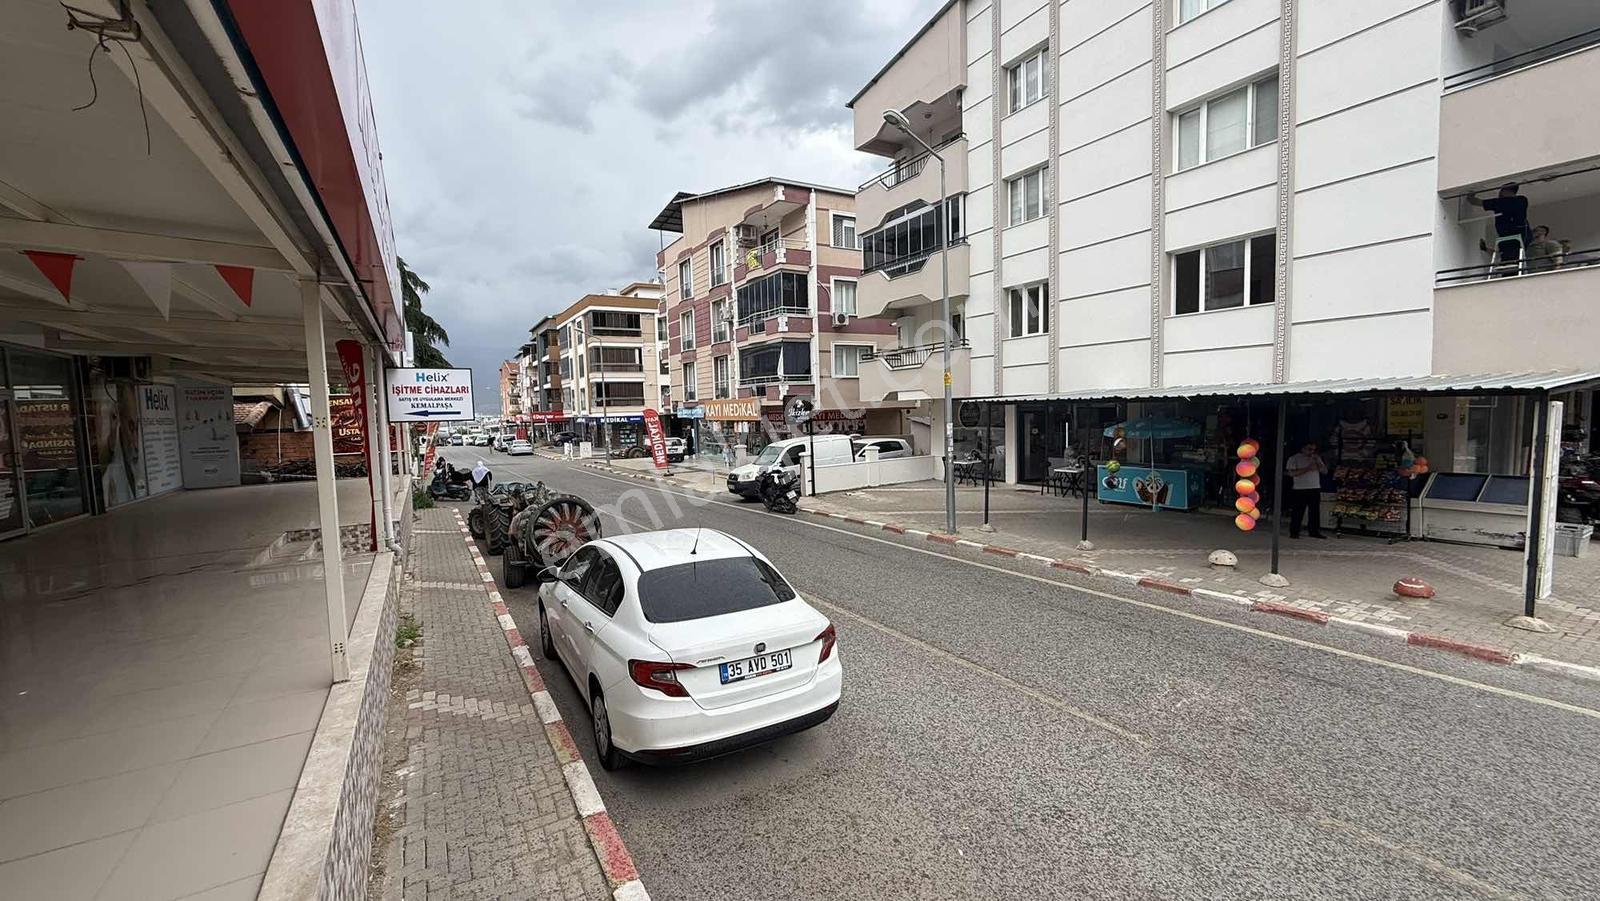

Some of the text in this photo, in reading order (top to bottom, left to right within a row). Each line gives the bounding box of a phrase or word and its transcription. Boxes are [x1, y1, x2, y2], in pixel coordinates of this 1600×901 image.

[416, 372, 448, 382] Helix
[392, 384, 469, 396] İŞİTME CİHAZLARI
[146, 389, 169, 410] Helix
[411, 402, 453, 410] KEMALPAŞA
[706, 404, 721, 416] KAYI
[723, 403, 757, 416] MEDİKAL
[728, 663, 743, 678] 35
[748, 656, 767, 673] AVD
[772, 651, 791, 666] 501
